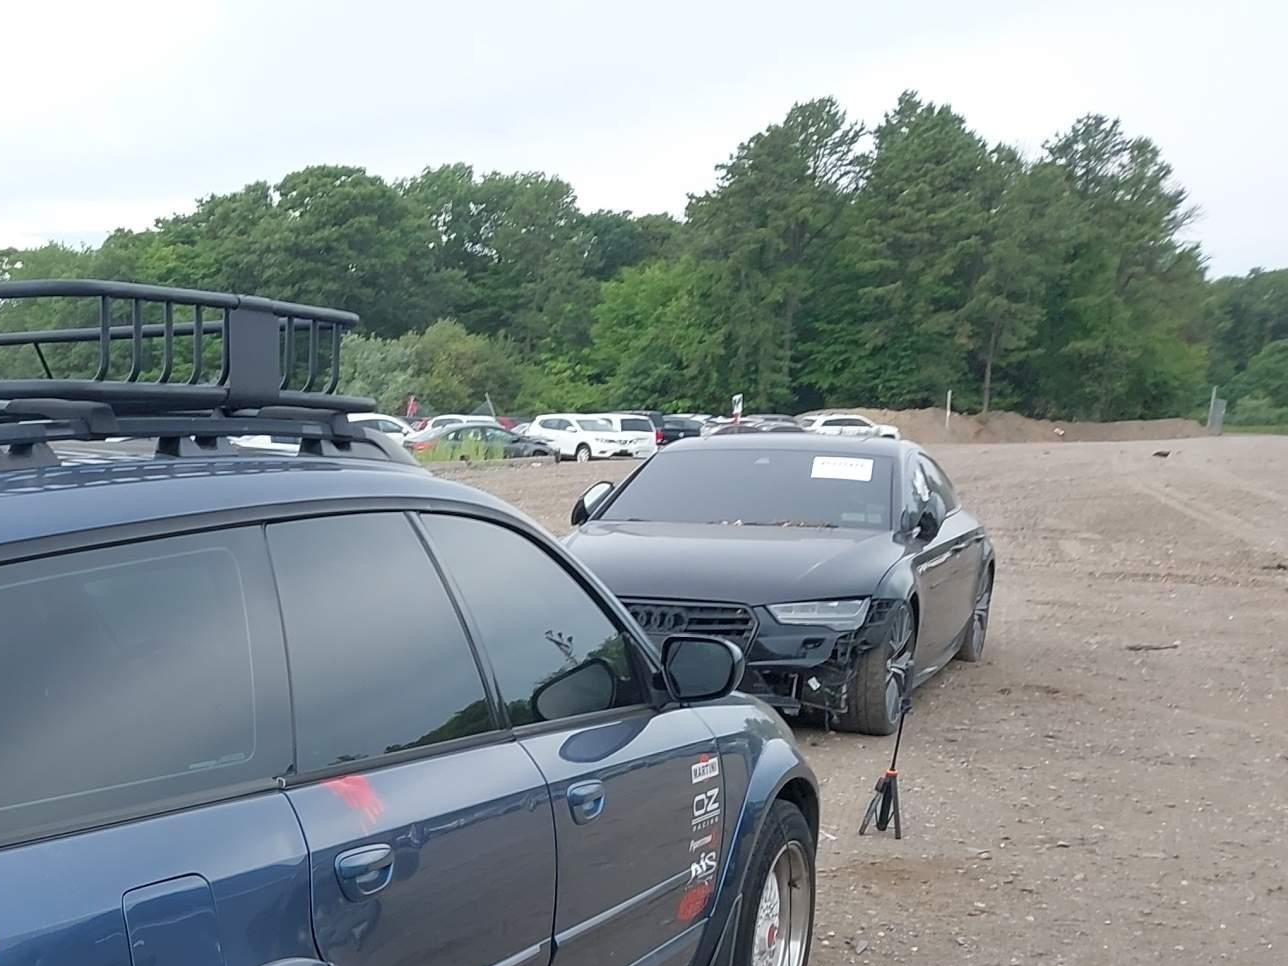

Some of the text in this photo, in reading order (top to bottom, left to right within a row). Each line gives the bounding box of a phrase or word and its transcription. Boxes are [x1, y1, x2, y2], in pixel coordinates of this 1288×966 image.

[693, 760, 717, 779] MARTINI
[693, 787, 720, 817] OZ
[692, 816, 720, 833] RACING
